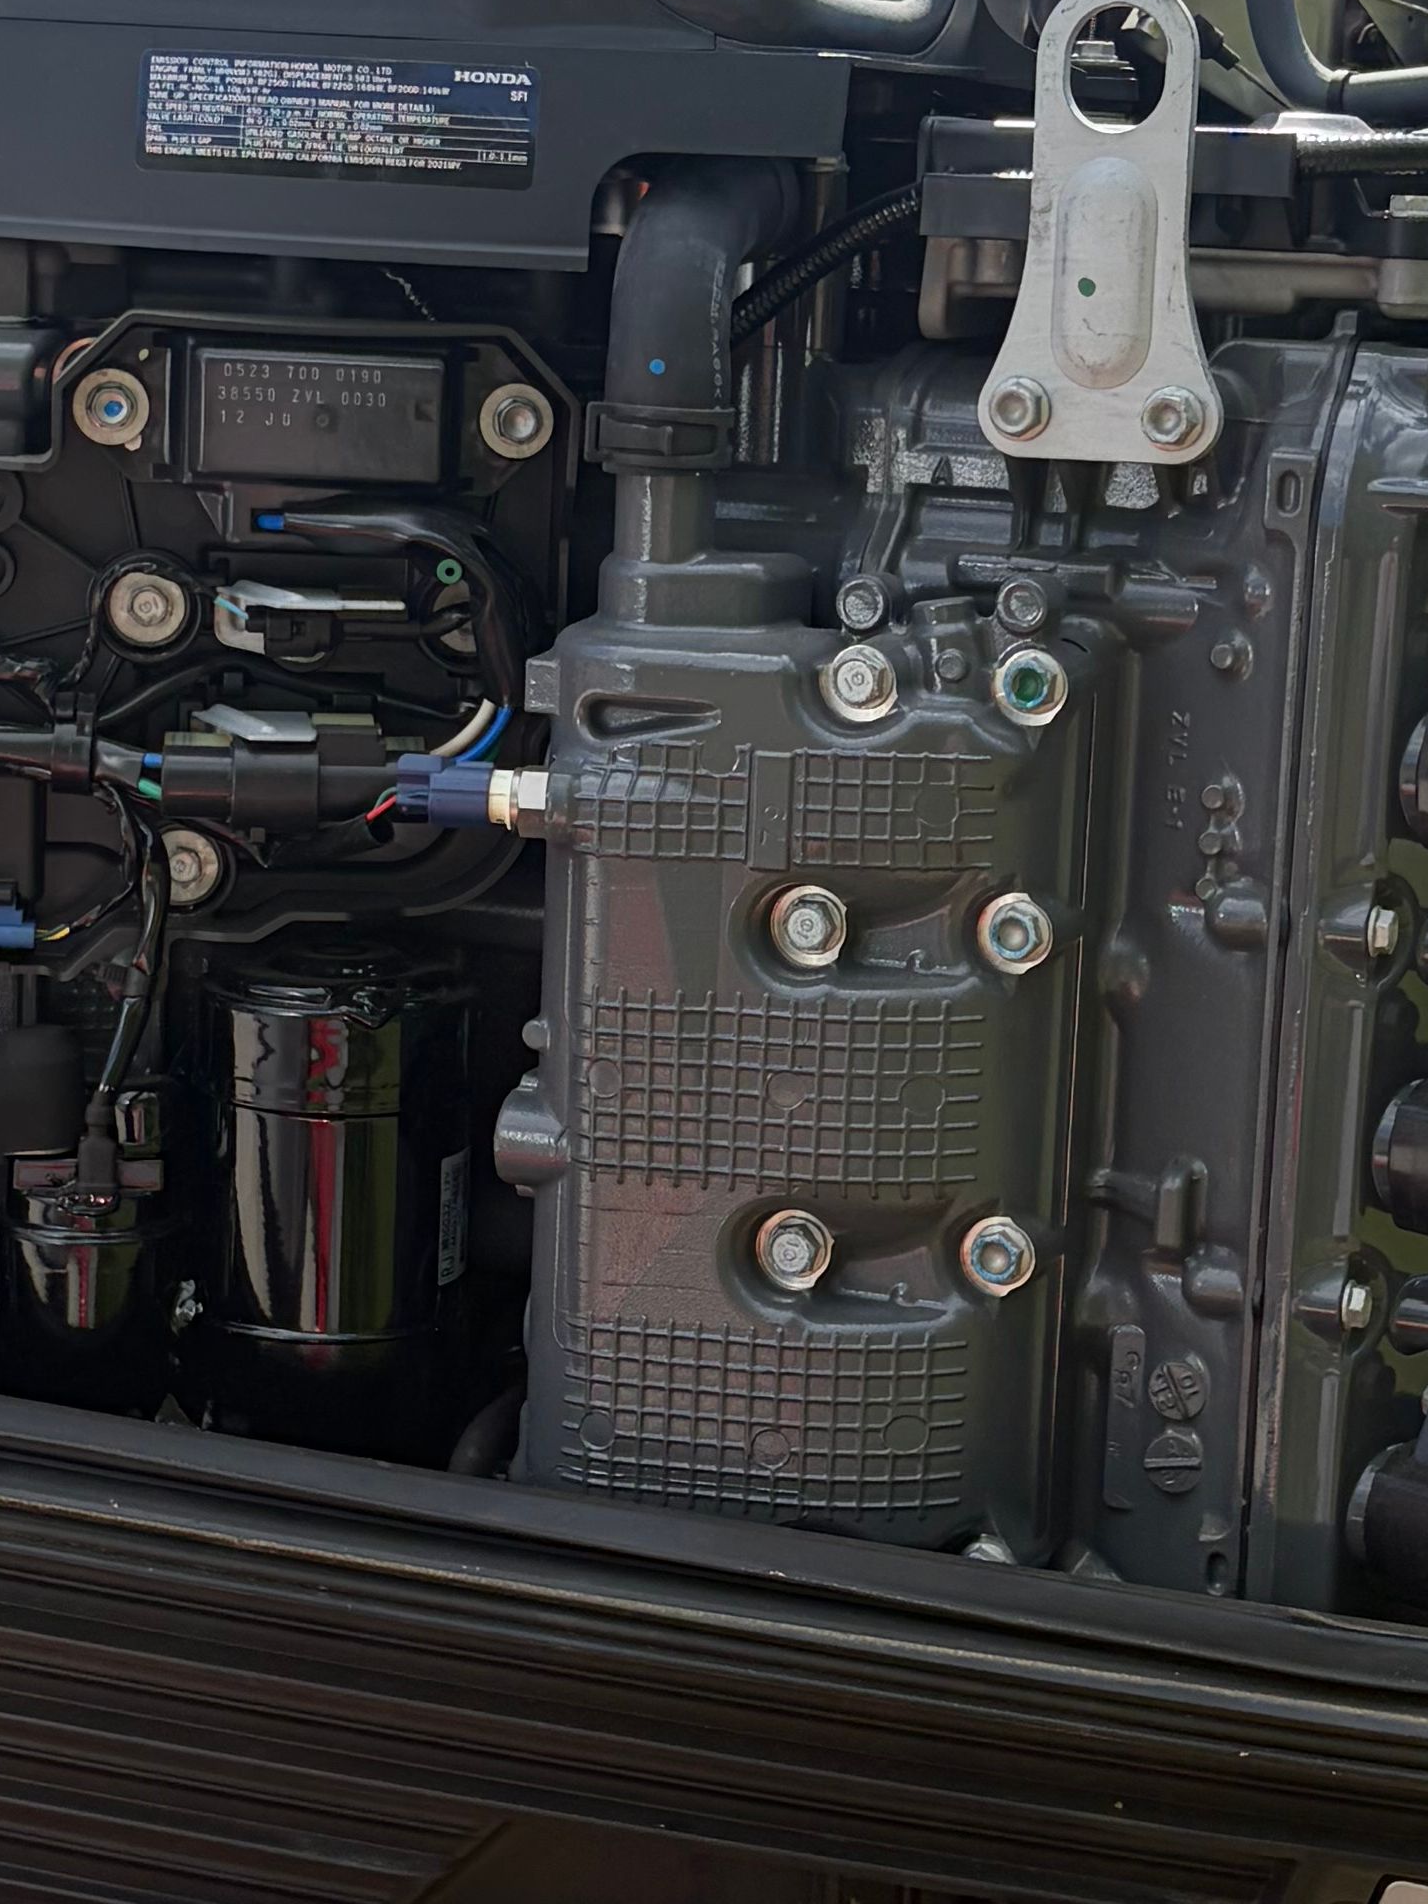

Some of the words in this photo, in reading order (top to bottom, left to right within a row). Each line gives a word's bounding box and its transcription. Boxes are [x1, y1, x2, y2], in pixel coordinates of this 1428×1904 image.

[192, 57, 228, 66] CONTROL
[323, 63, 352, 72] MOTOR
[454, 70, 532, 86] HONDA
[510, 90, 528, 102] SFI
[224, 362, 270, 379] 0523
[287, 365, 319, 381] 700
[336, 368, 381, 384] 0190
[218, 386, 276, 402] 38550
[292, 389, 324, 404] ZVL
[341, 391, 386, 407] 0030
